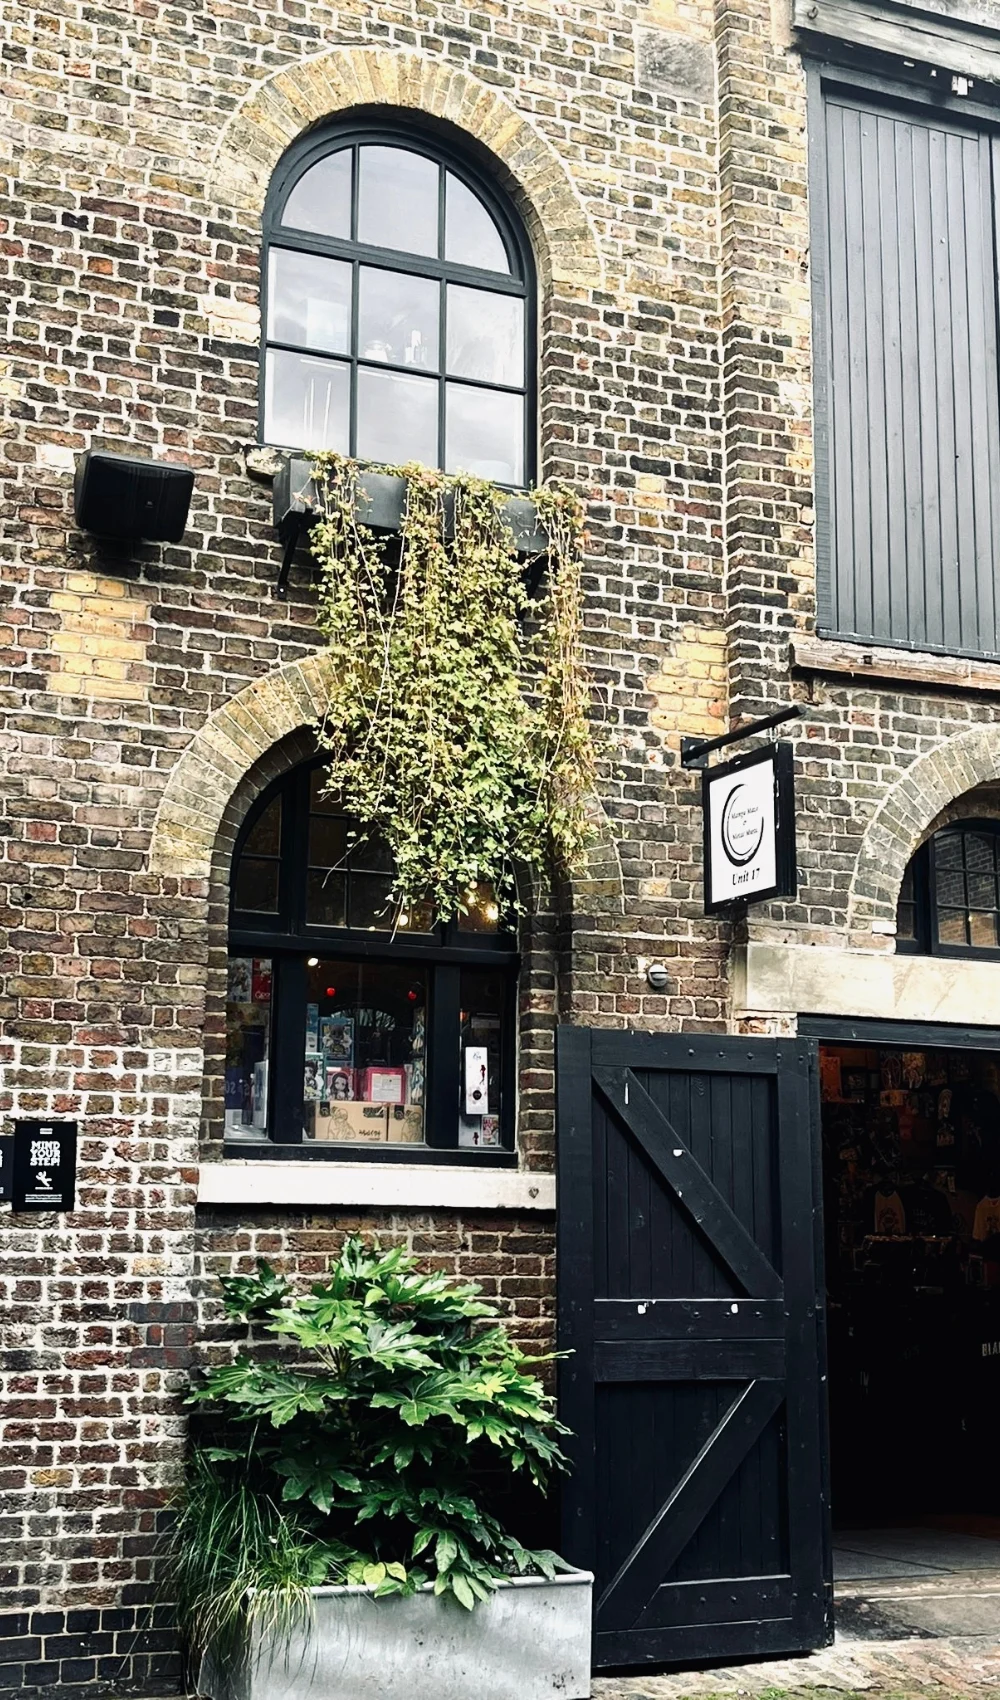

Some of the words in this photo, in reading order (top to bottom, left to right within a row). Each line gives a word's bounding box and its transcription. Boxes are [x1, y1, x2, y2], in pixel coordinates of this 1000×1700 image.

[732, 869, 749, 886] Unit
[751, 867, 760, 881] 17
[31, 1140, 61, 1150] MIND
[29, 1149, 61, 1159] YOUR
